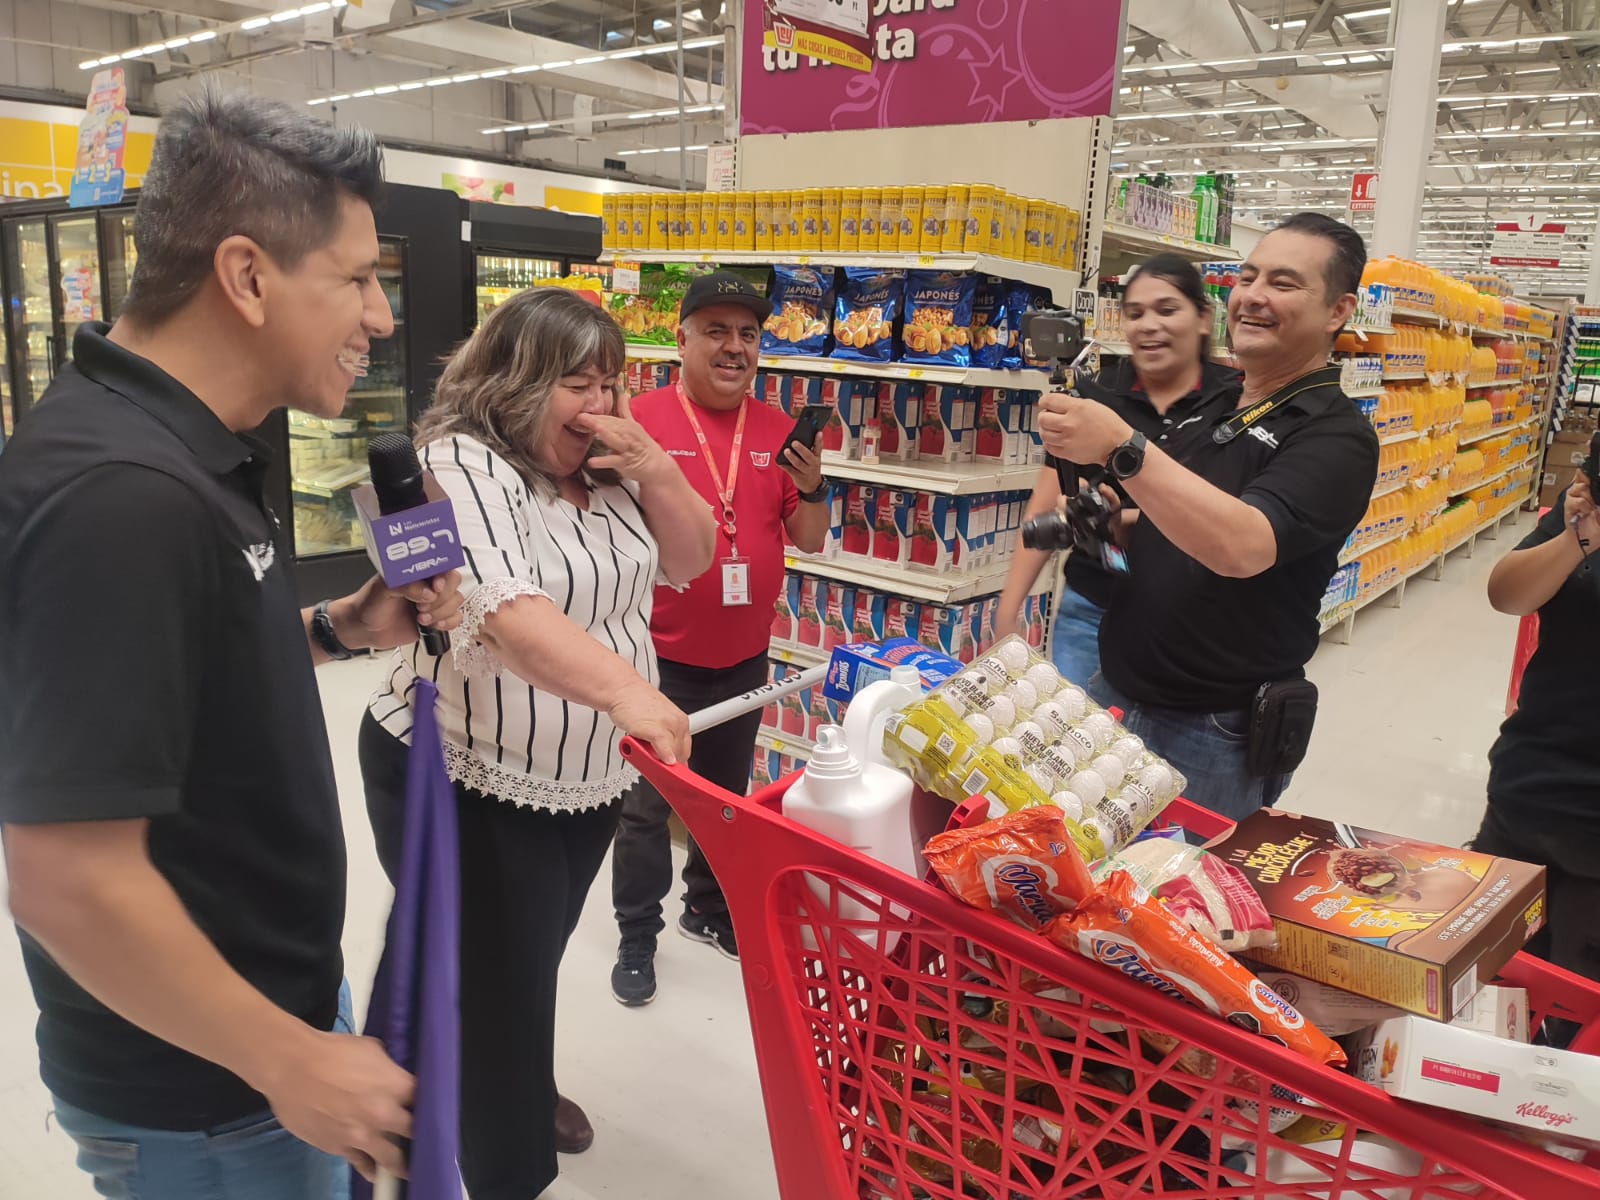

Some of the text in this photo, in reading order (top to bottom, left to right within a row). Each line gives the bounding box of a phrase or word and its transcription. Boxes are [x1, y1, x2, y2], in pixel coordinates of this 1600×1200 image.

[808, 40, 823, 54] COSAS
[827, 45, 846, 61] MEJORES
[846, 49, 864, 65] PRECIOS
[1528, 214, 1534, 227] 1
[785, 285, 823, 297] JAPONÉS
[853, 289, 889, 303] JAPONÉS
[914, 289, 960, 301] JAPONÉS
[1242, 401, 1273, 424] Nikon
[386, 529, 455, 561] 89.7
[402, 556, 449, 574] VIBRA
[982, 657, 1018, 686] achoco
[968, 681, 996, 707] BLANCO
[1051, 709, 1092, 750] Bachoco
[1024, 729, 1046, 752] HUEVO
[1045, 745, 1072, 775] BLANCO
[1045, 757, 1068, 780] GRANJA
[1101, 795, 1125, 817] HUEVO
[1243, 842, 1283, 869] MEJOR
[1516, 1102, 1575, 1127] Kellogg's
